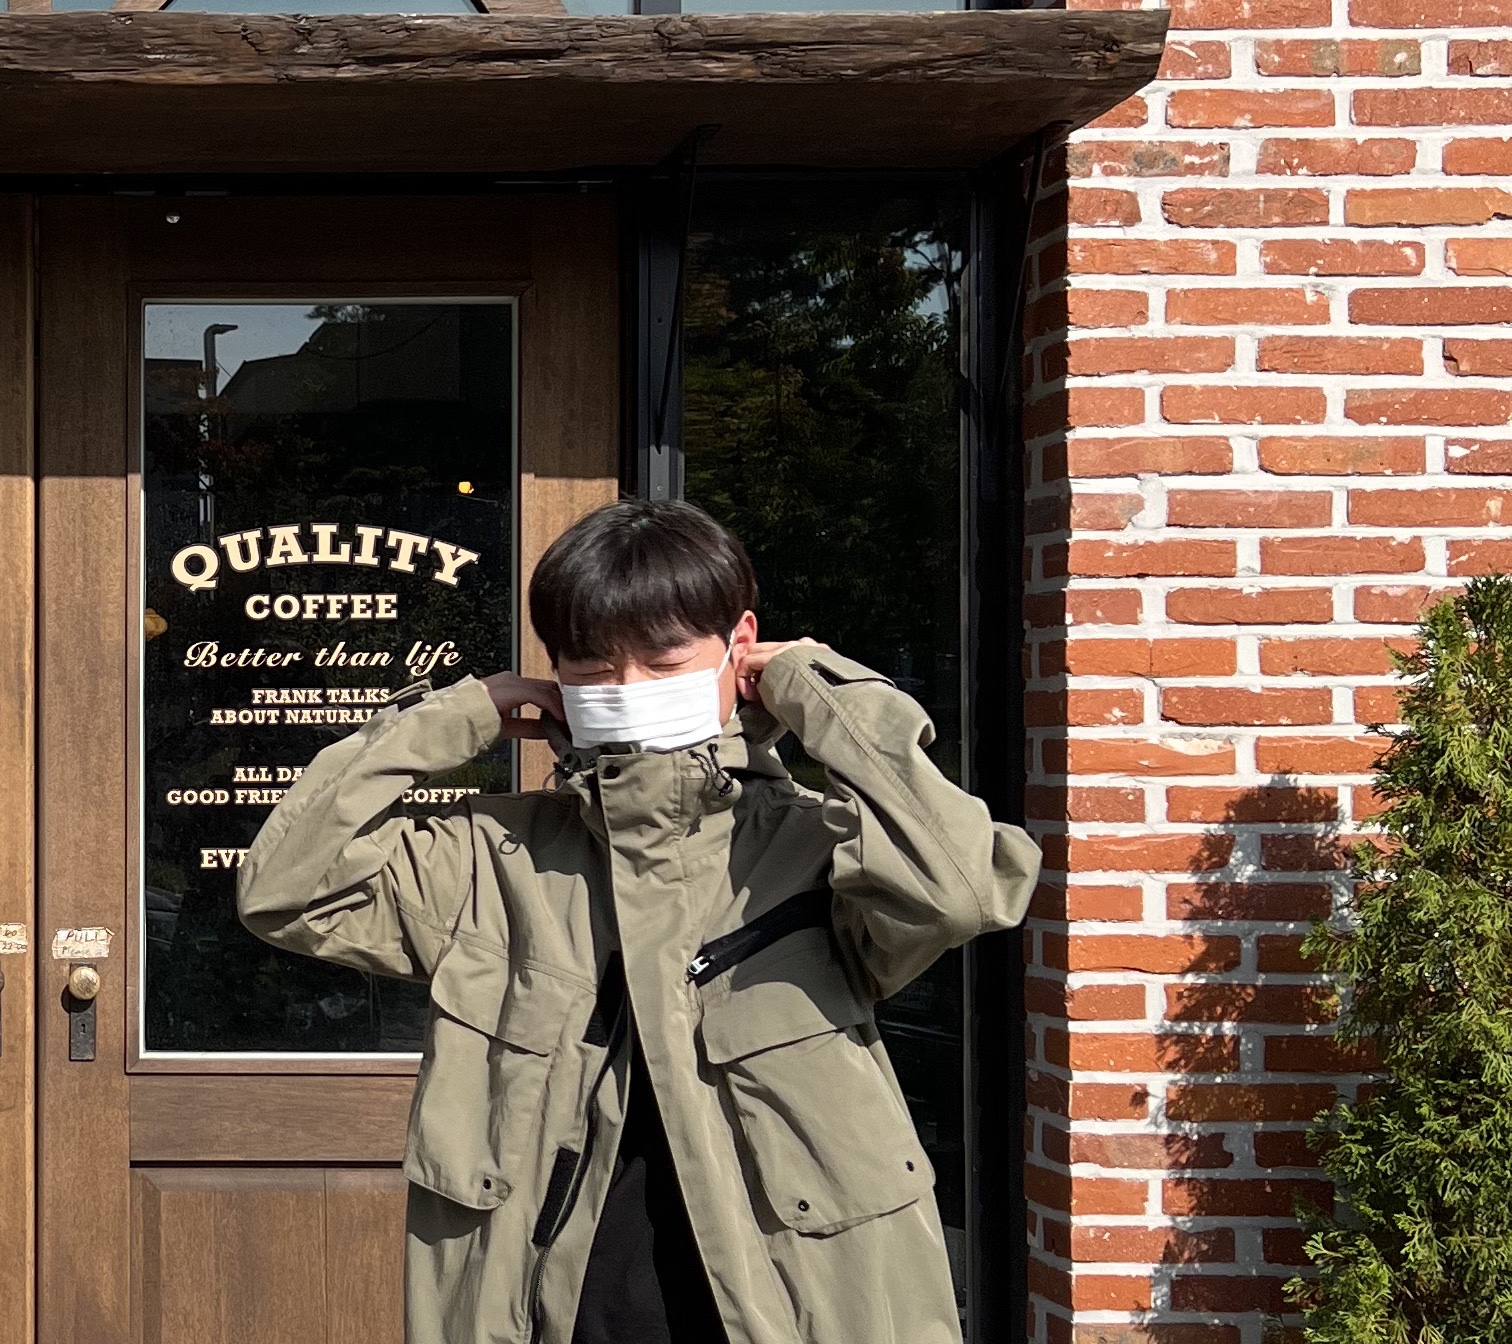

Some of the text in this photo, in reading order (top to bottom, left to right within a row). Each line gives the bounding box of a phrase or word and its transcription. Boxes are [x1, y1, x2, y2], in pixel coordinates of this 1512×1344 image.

[170, 521, 480, 592] QUALITY
[245, 594, 398, 620] COFFEE
[183, 640, 463, 677] Better than life
[251, 688, 389, 704] FRANK TALKS
[209, 709, 280, 724] ABOUT
[233, 767, 308, 782] ALL DA
[167, 789, 230, 804] GOOD
[65, 930, 106, 942] PULL
